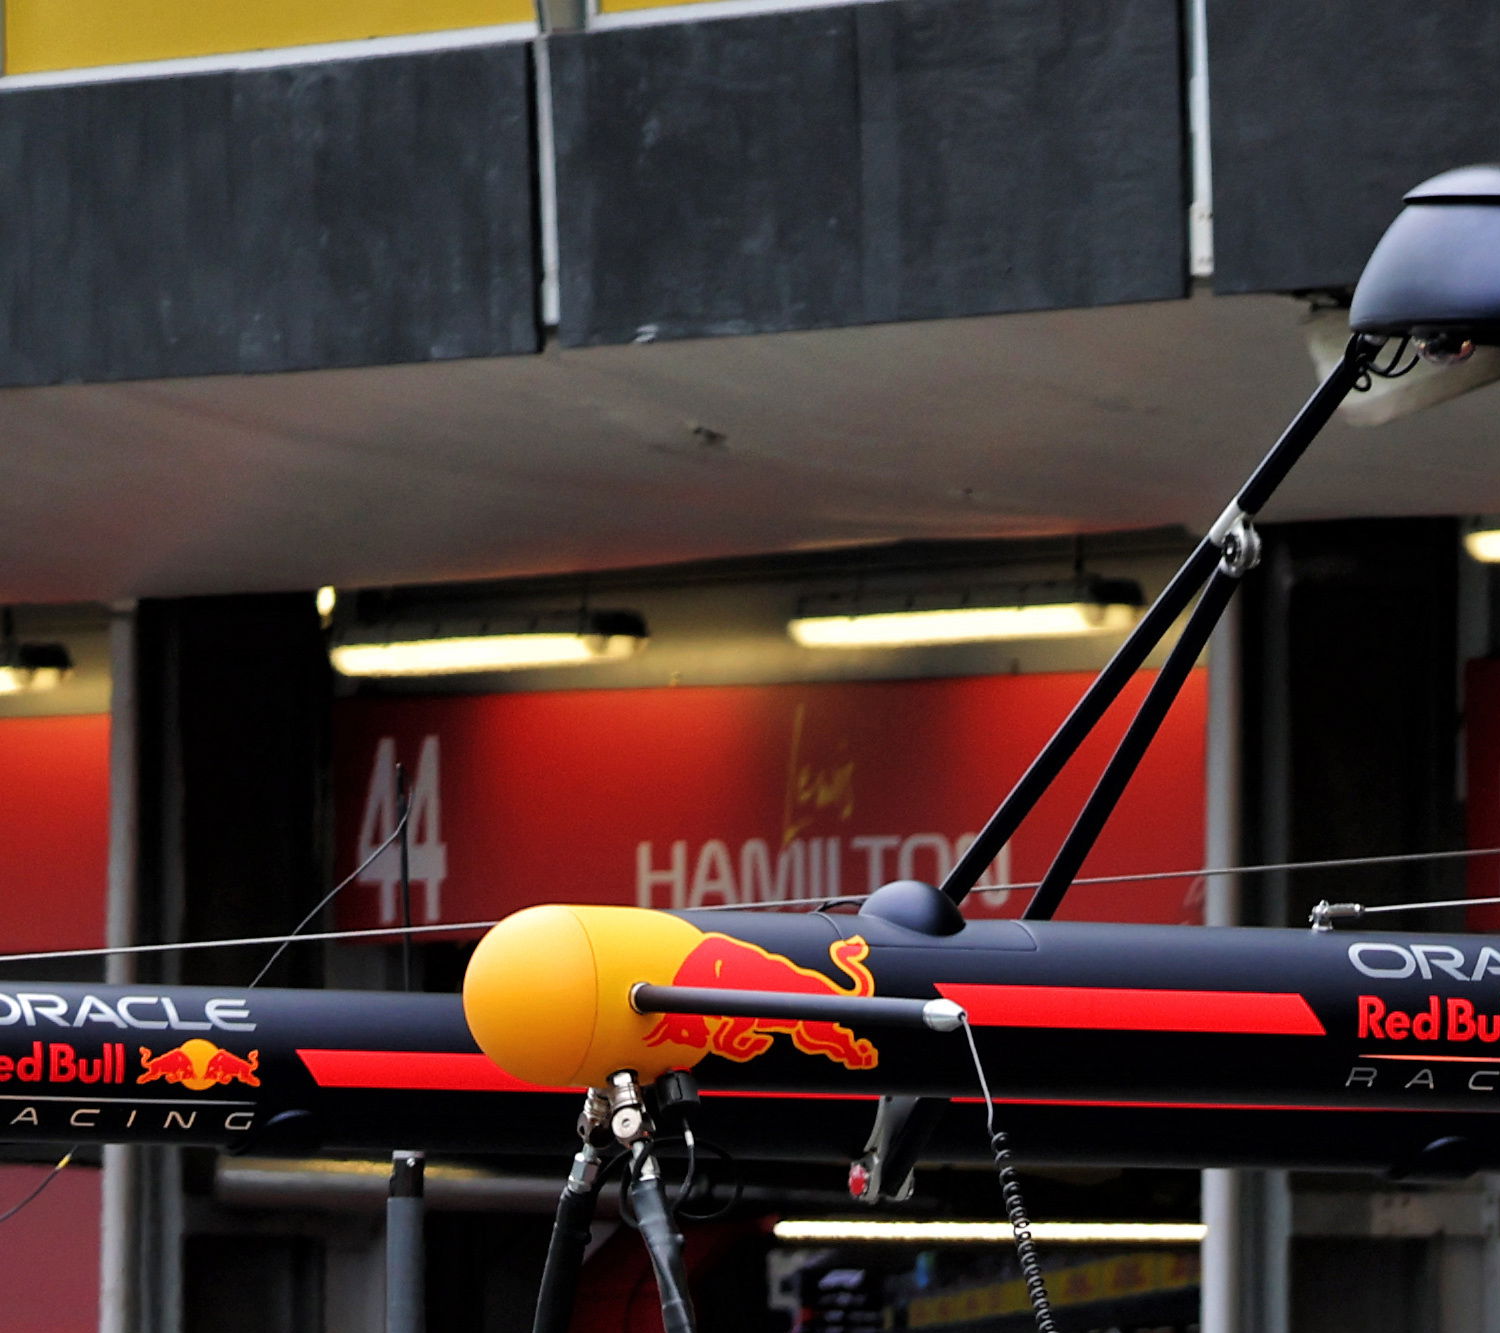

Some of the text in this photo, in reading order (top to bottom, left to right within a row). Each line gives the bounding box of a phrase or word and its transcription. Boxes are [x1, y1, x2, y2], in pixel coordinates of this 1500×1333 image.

[358, 734, 448, 924] 44
[1357, 994, 1439, 1042] Red
[0, 1041, 125, 1085] ed Bull
[10, 1108, 256, 1131] ACING
